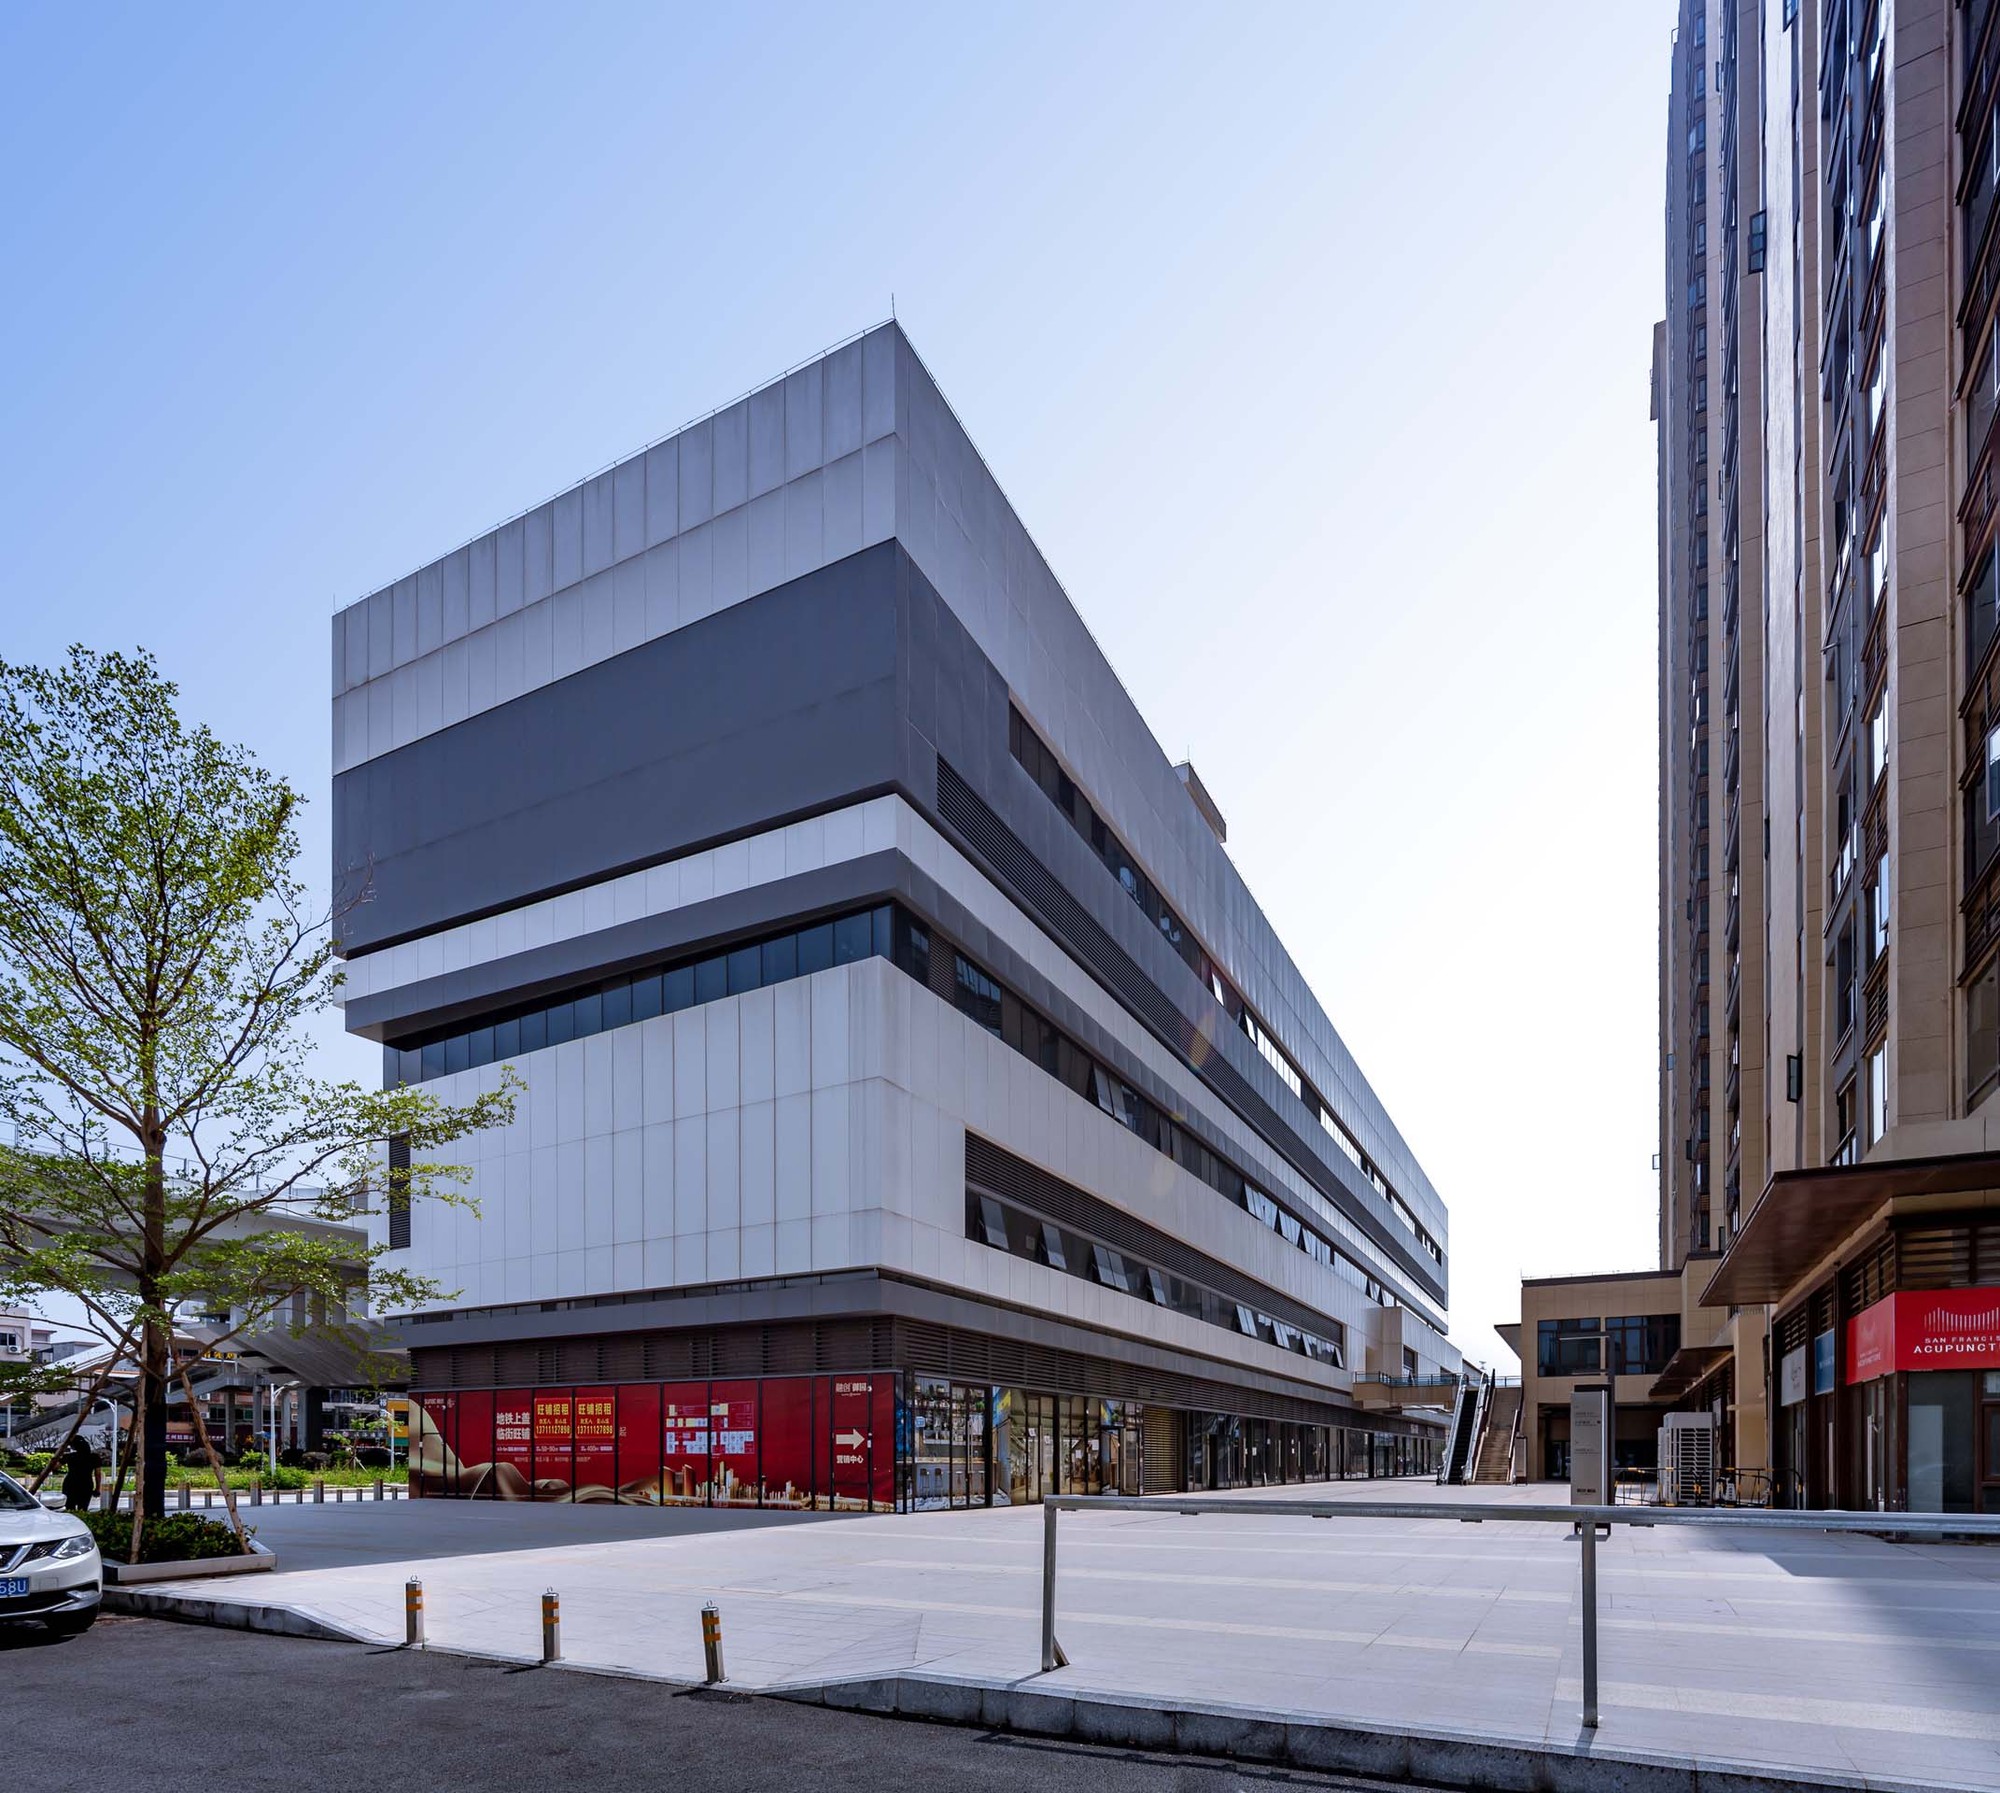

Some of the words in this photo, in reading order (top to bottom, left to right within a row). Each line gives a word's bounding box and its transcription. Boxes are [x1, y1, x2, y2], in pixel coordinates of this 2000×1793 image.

[1913, 1343, 2000, 1354] ACUPUNCT
[537, 1403, 569, 1416] 旺铺招租
[578, 1403, 612, 1416] 旺铺招租
[496, 1411, 531, 1425] 地铁上盖
[496, 1427, 531, 1440] 临街旺铺
[836, 1454, 864, 1464] 营销中心
